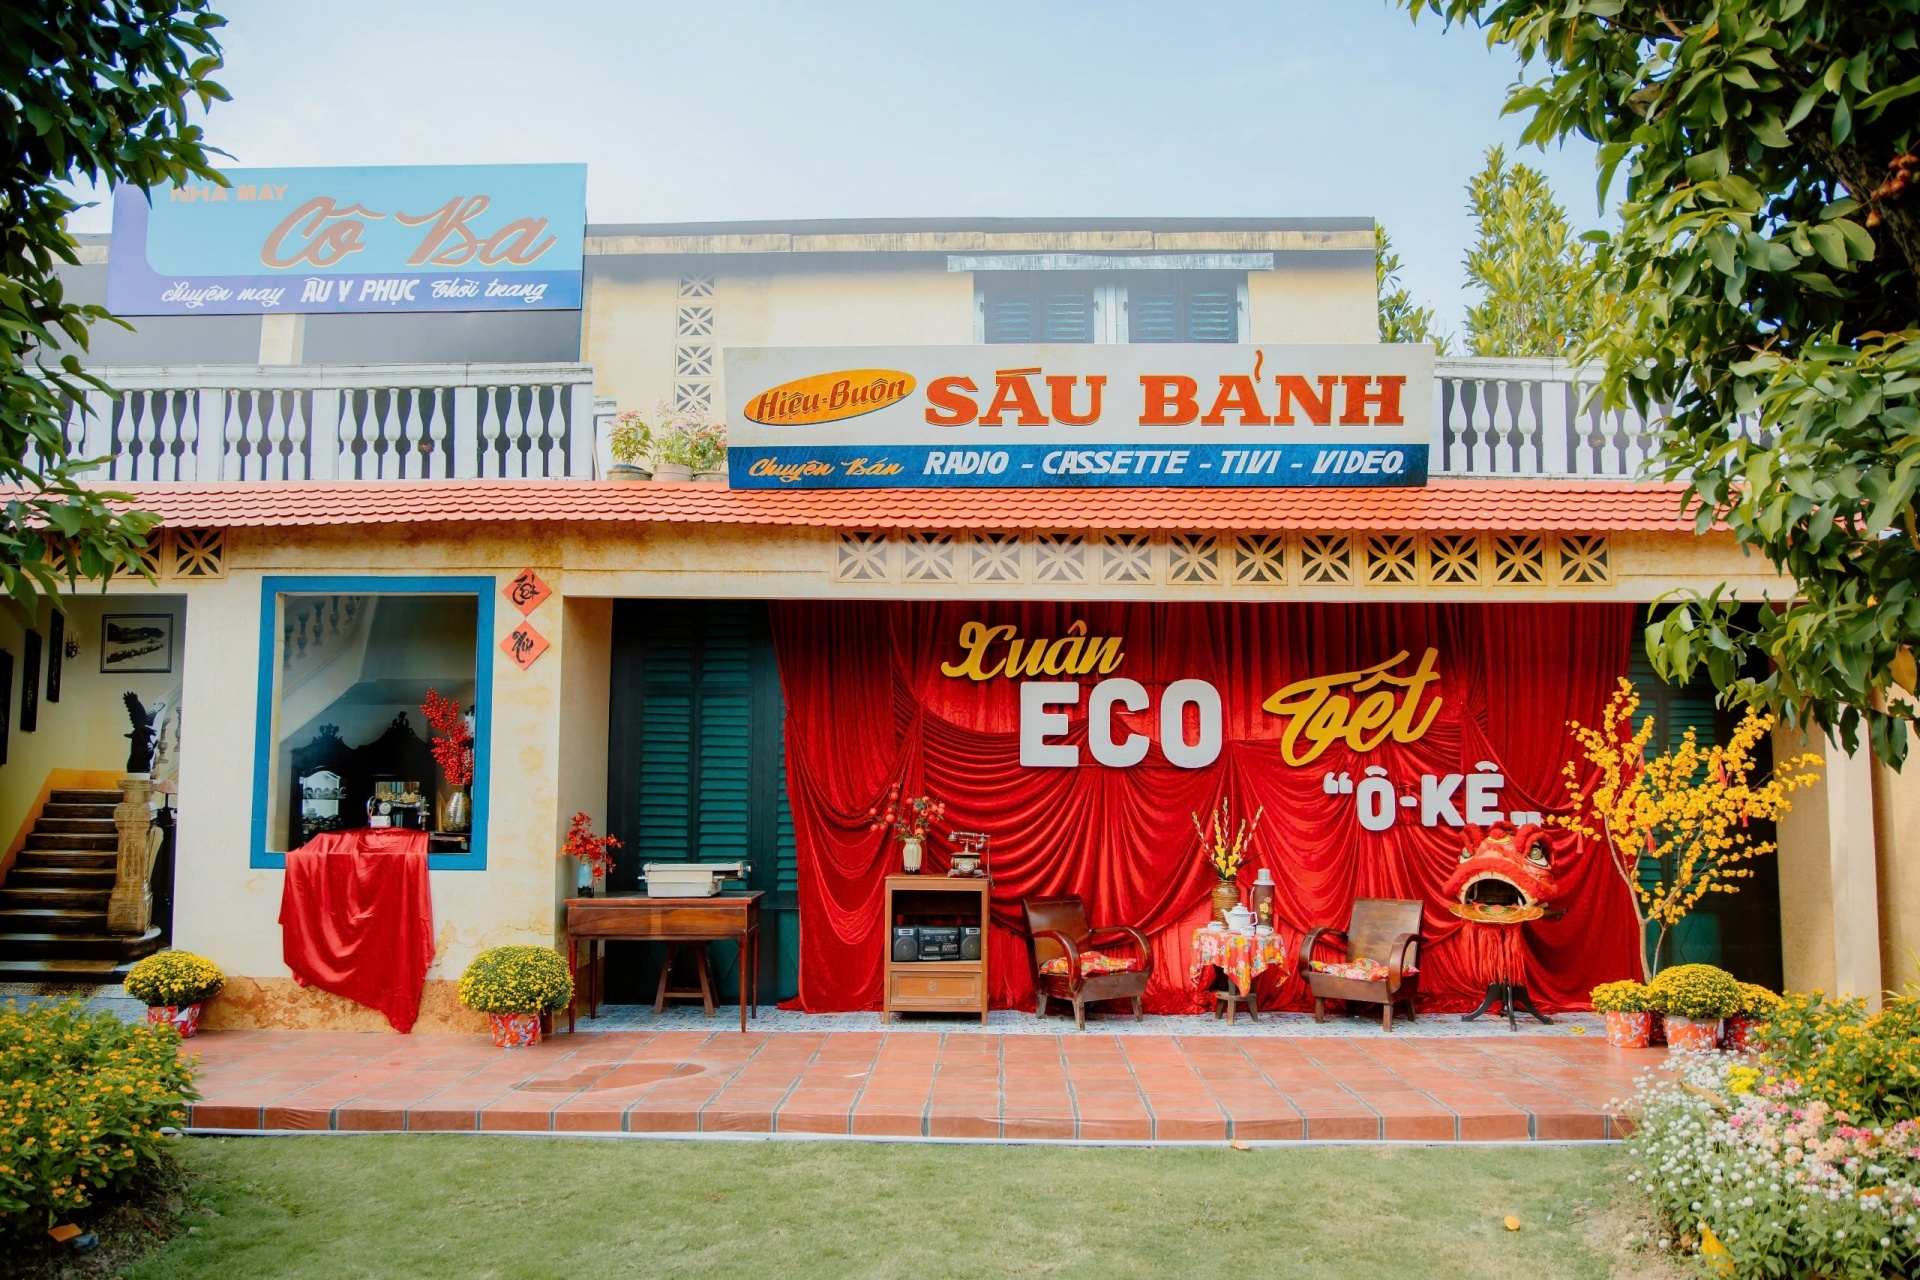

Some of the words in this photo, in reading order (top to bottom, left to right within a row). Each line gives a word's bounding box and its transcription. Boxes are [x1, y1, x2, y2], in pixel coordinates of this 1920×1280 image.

[236, 183, 289, 203] MAY
[261, 195, 386, 269] Cô
[394, 194, 557, 267] Ba
[237, 287, 286, 308] may
[300, 277, 334, 303] ÂU
[338, 280, 354, 302] Y
[358, 279, 420, 306] PHỤC
[484, 278, 549, 304] trang
[749, 457, 835, 483] Chuyên
[841, 457, 905, 477] Bán
[922, 451, 1010, 475] RADIO
[1042, 450, 1191, 475] CASSETTE
[1220, 450, 1282, 474] TIVI
[1311, 450, 1405, 475] VIDEO.
[940, 619, 1127, 681] Xuân
[1019, 677, 1224, 769] ECO
[1262, 647, 1444, 767] Tết
